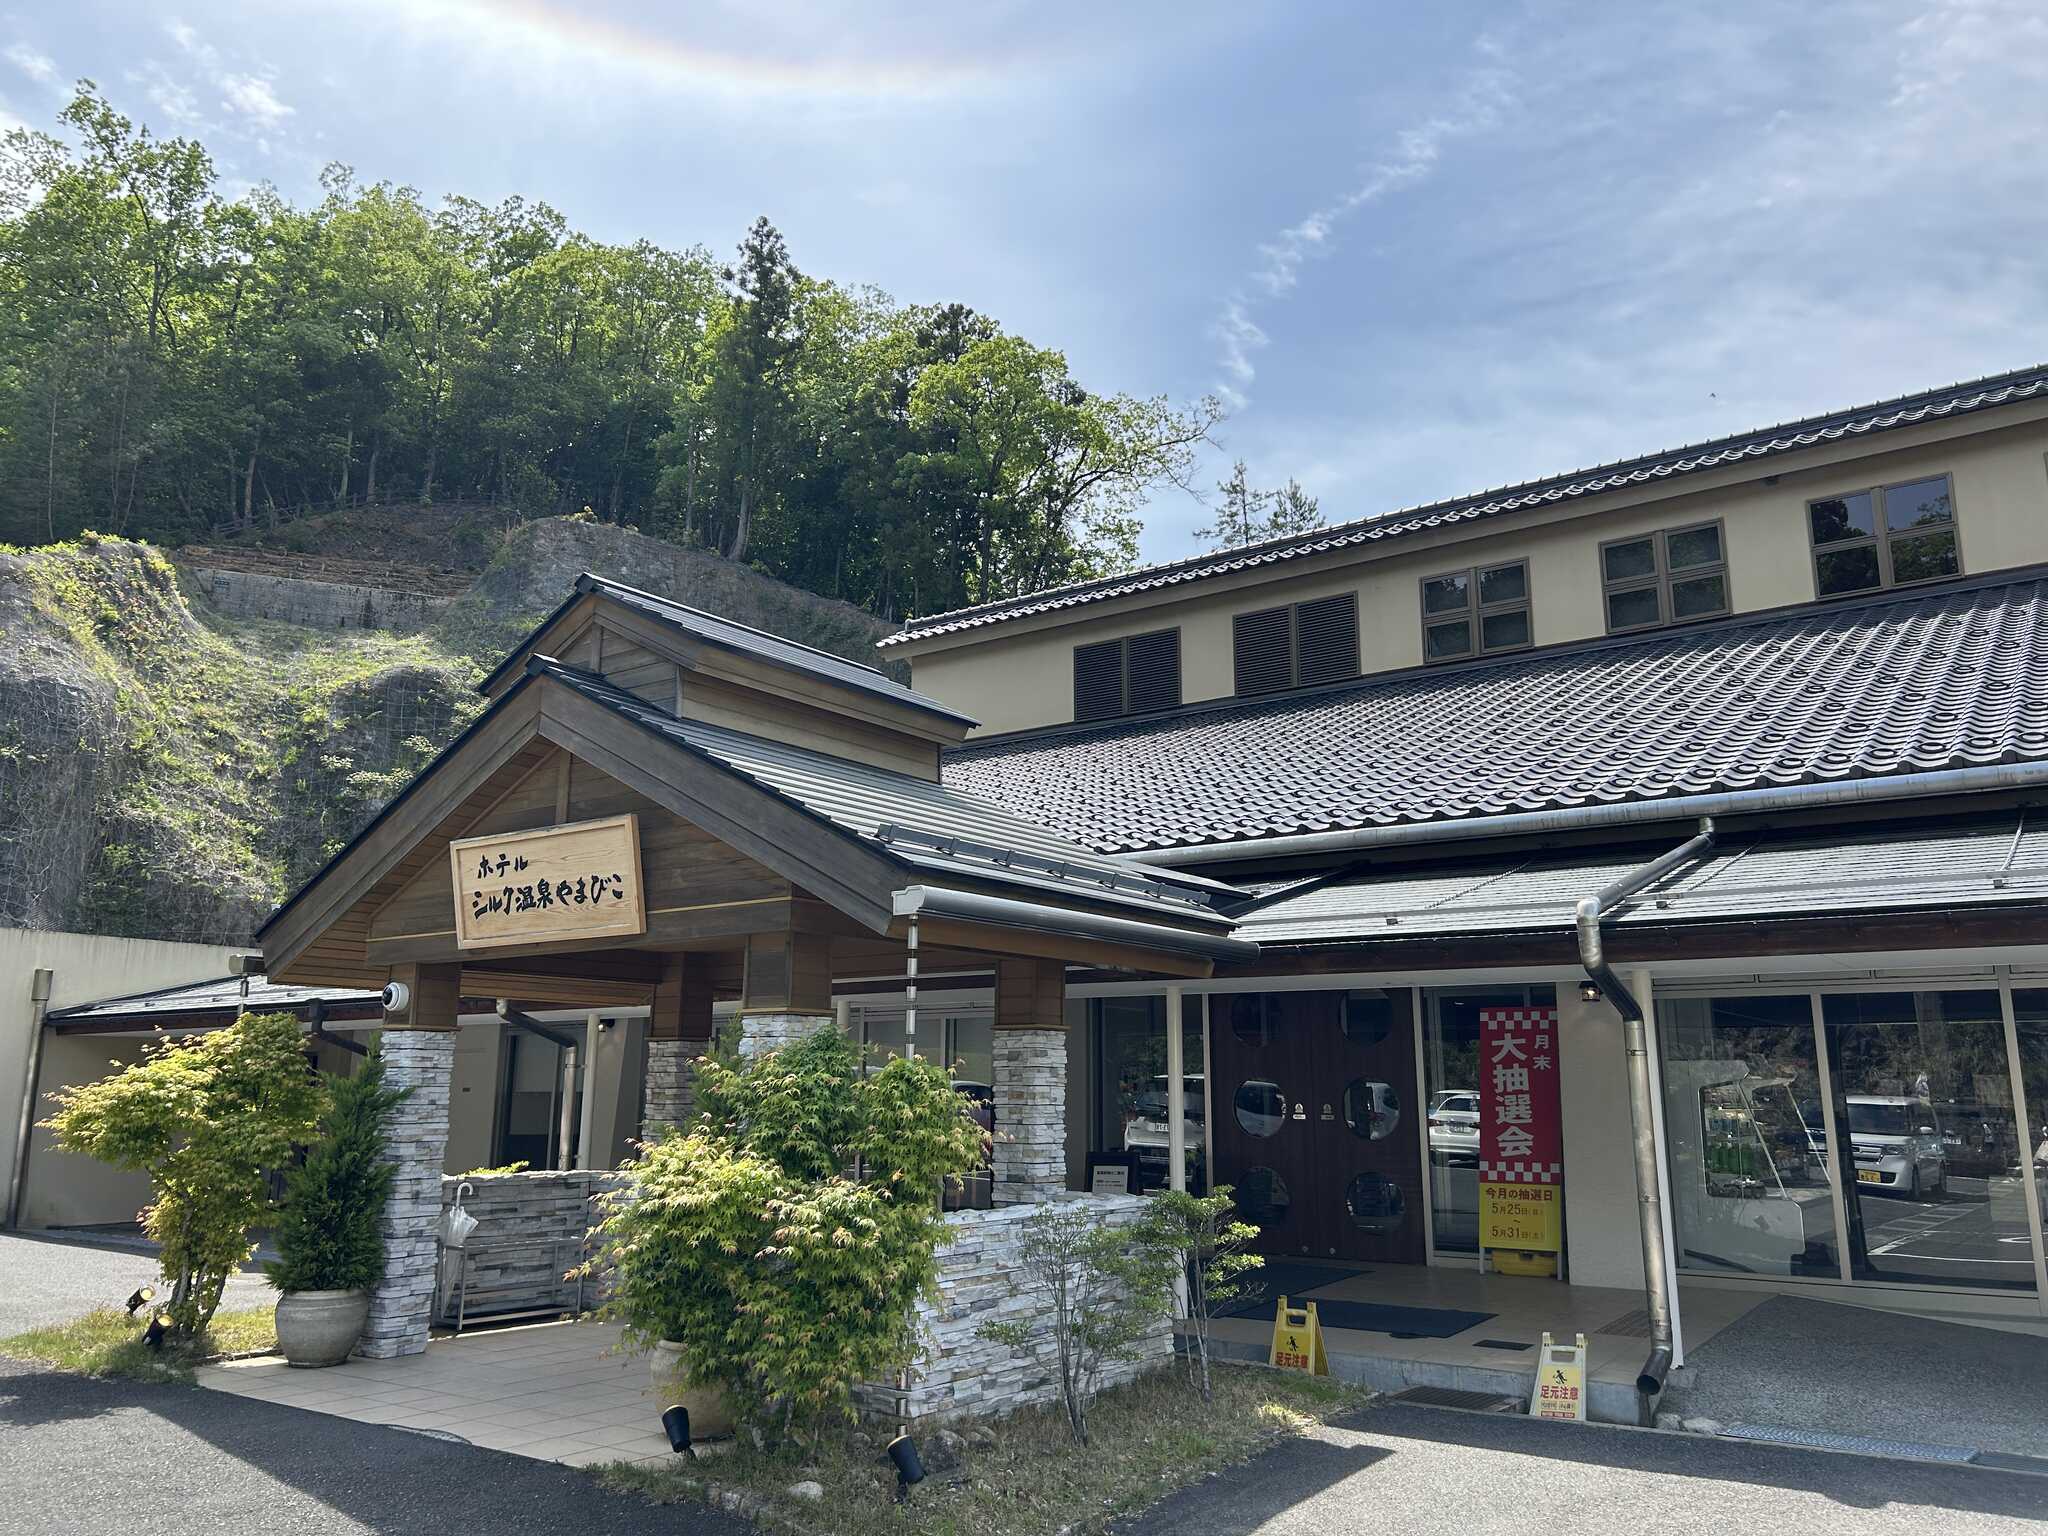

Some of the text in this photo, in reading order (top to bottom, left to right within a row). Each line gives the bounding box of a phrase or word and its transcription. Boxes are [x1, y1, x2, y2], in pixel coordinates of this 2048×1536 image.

[477, 853, 529, 879] ホテル
[472, 873, 624, 920] シルク温泉やまびこ
[1532, 1034, 1553, 1071] 月末
[1491, 1032, 1535, 1158] 大抽選会
[1486, 1187, 1553, 1201] 今月の抽選日
[1540, 1384, 1579, 1401] 足元注意
